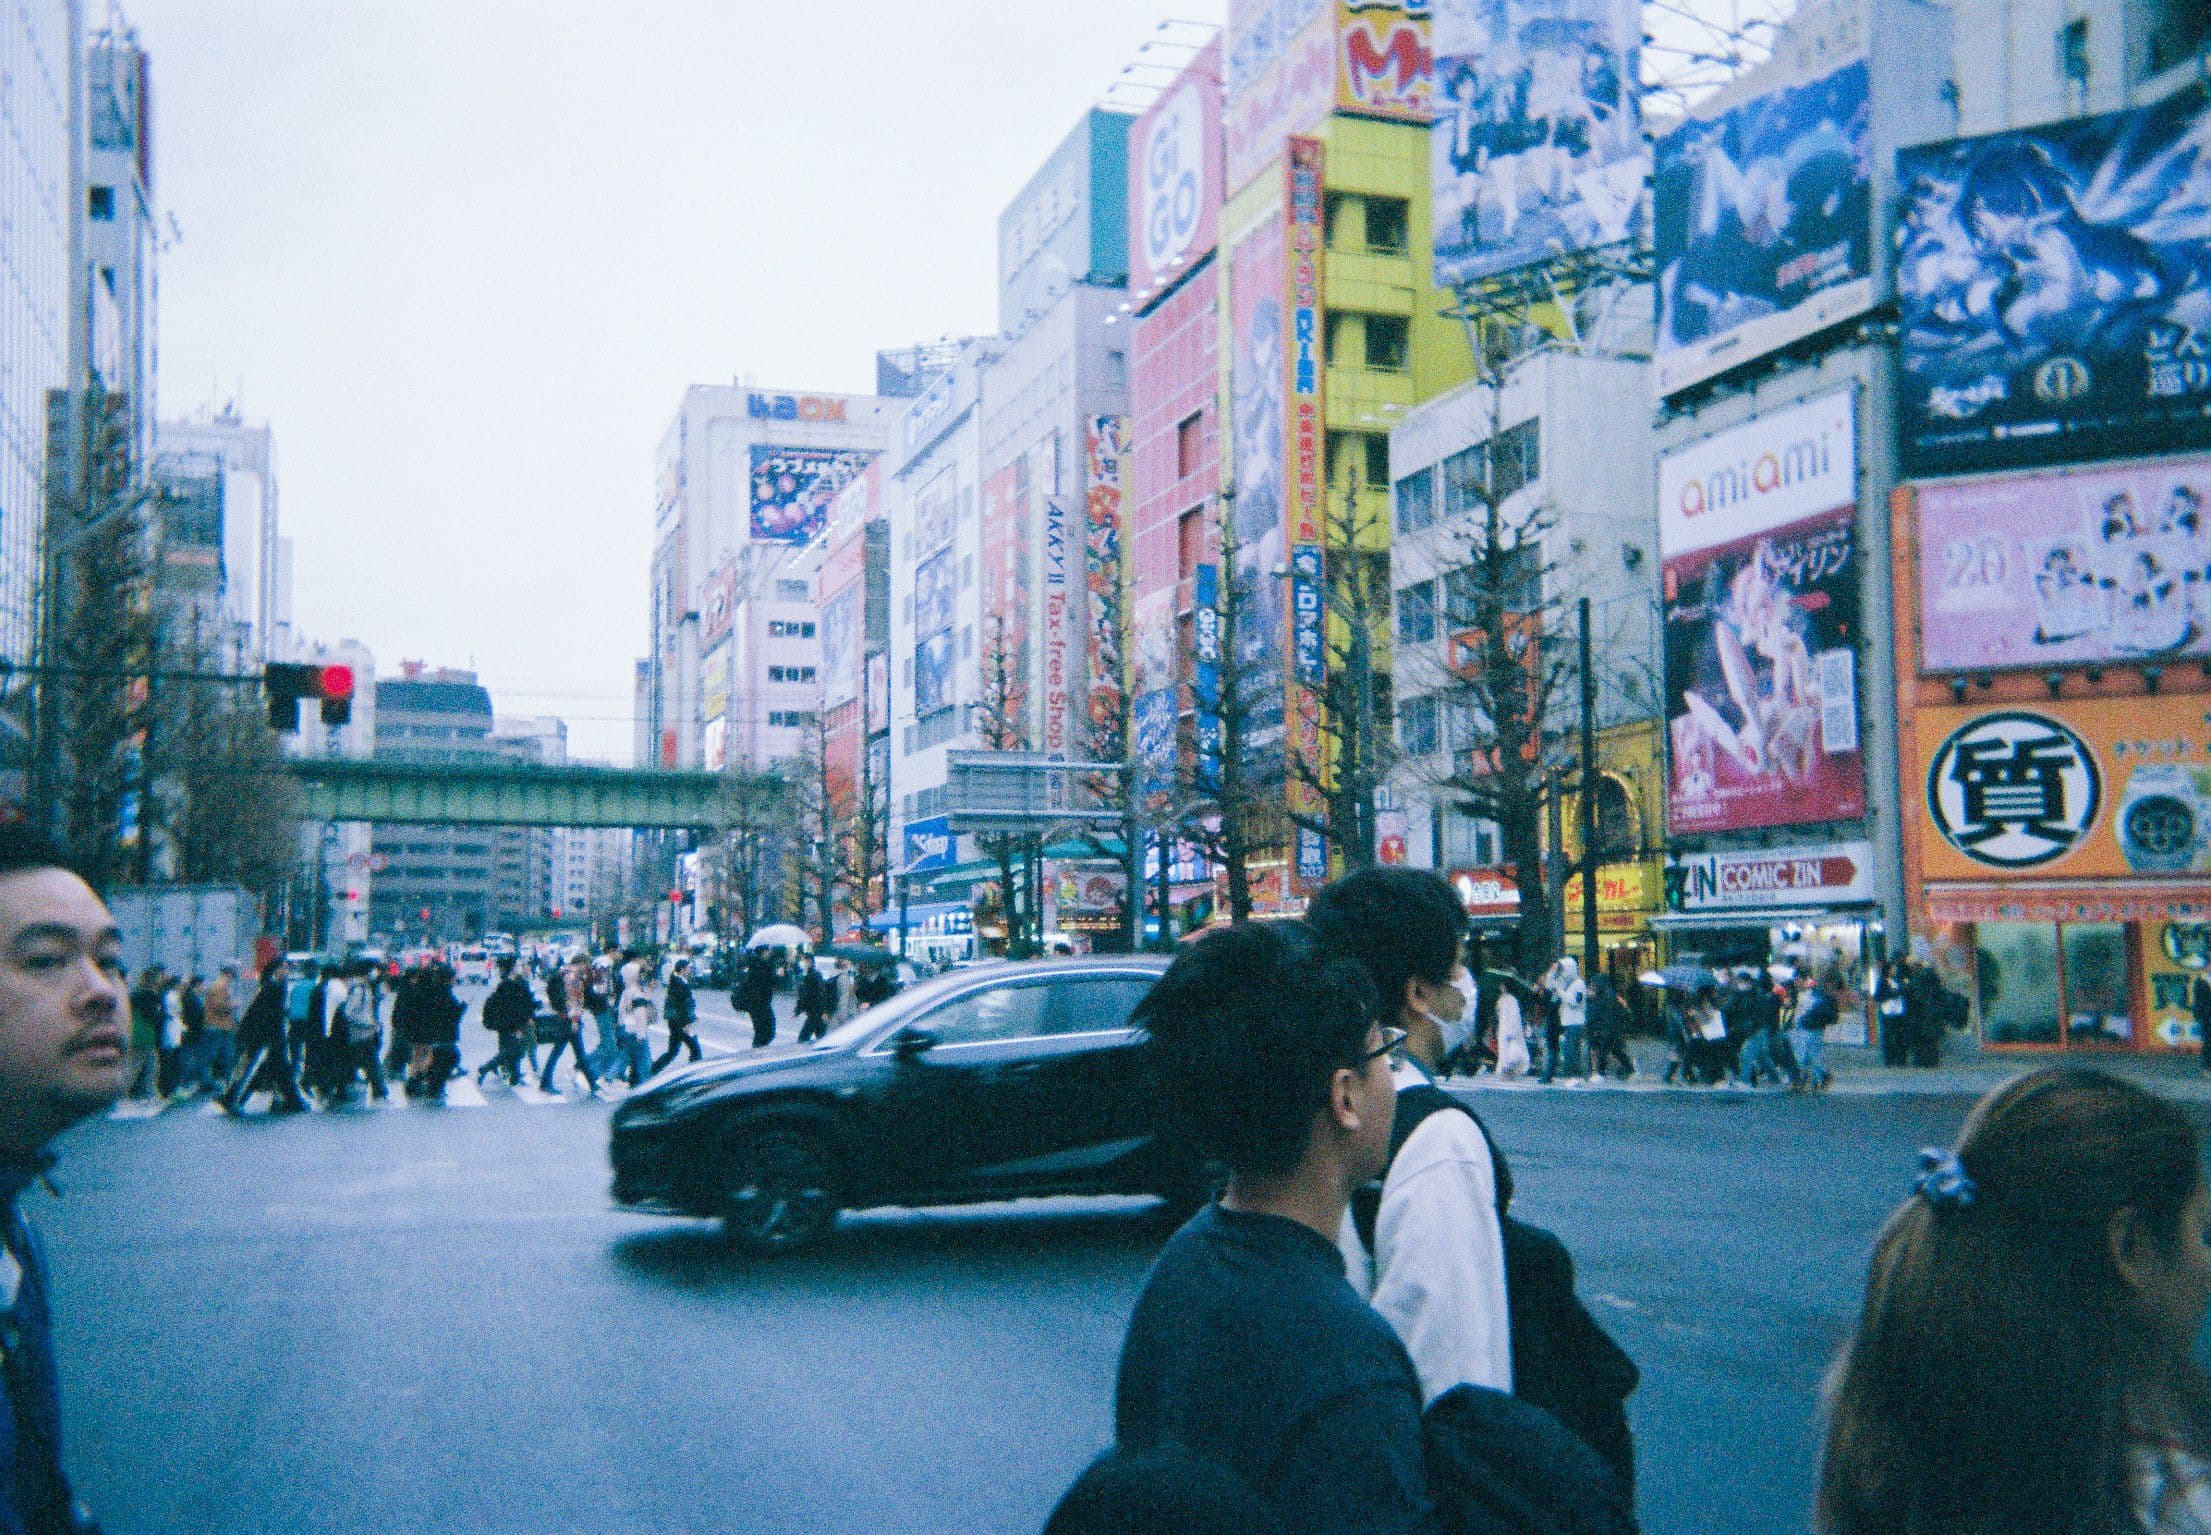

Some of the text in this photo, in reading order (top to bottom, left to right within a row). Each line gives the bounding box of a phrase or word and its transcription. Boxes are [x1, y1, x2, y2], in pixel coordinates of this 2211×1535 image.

[1681, 433, 1829, 518] amiami
[1047, 502, 1065, 567] AKKY
[1047, 591, 1067, 689] Tax-free
[1047, 693, 1067, 749] Shop
[1951, 733, 2080, 848] 質
[1723, 861, 1788, 892] COMIC
[1793, 859, 1822, 887] ZIN
